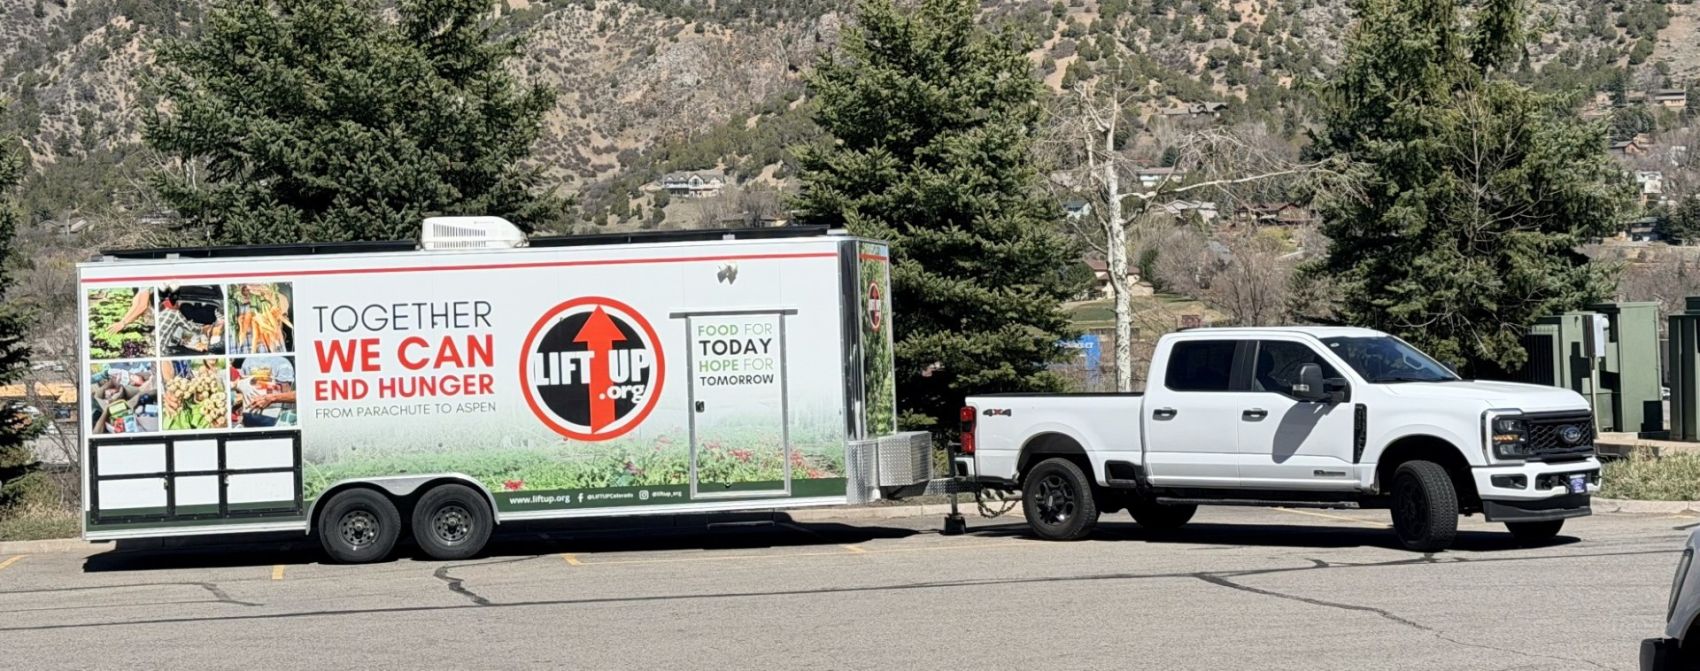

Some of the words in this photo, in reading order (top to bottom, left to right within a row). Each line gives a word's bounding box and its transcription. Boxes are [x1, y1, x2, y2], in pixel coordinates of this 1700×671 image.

[312, 300, 492, 333] TOGETHER
[698, 325, 739, 336] FOOD
[744, 323, 773, 335] FOR
[314, 338, 381, 373] WE
[397, 334, 494, 371] CAN
[699, 338, 772, 356] TODAY
[534, 350, 595, 386] LIFT
[608, 348, 651, 383] UP
[699, 360, 739, 373] HOPE
[743, 358, 774, 371] FOR
[315, 379, 369, 401] END
[379, 374, 494, 398] HUNGER
[700, 374, 774, 387] TOMORROW
[598, 382, 646, 404] .org
[315, 407, 354, 419] FROM
[357, 404, 431, 417] PARACHUTE
[435, 403, 452, 414] TO
[456, 402, 496, 413] ASPEN
[509, 493, 571, 504] www.liftup.org
